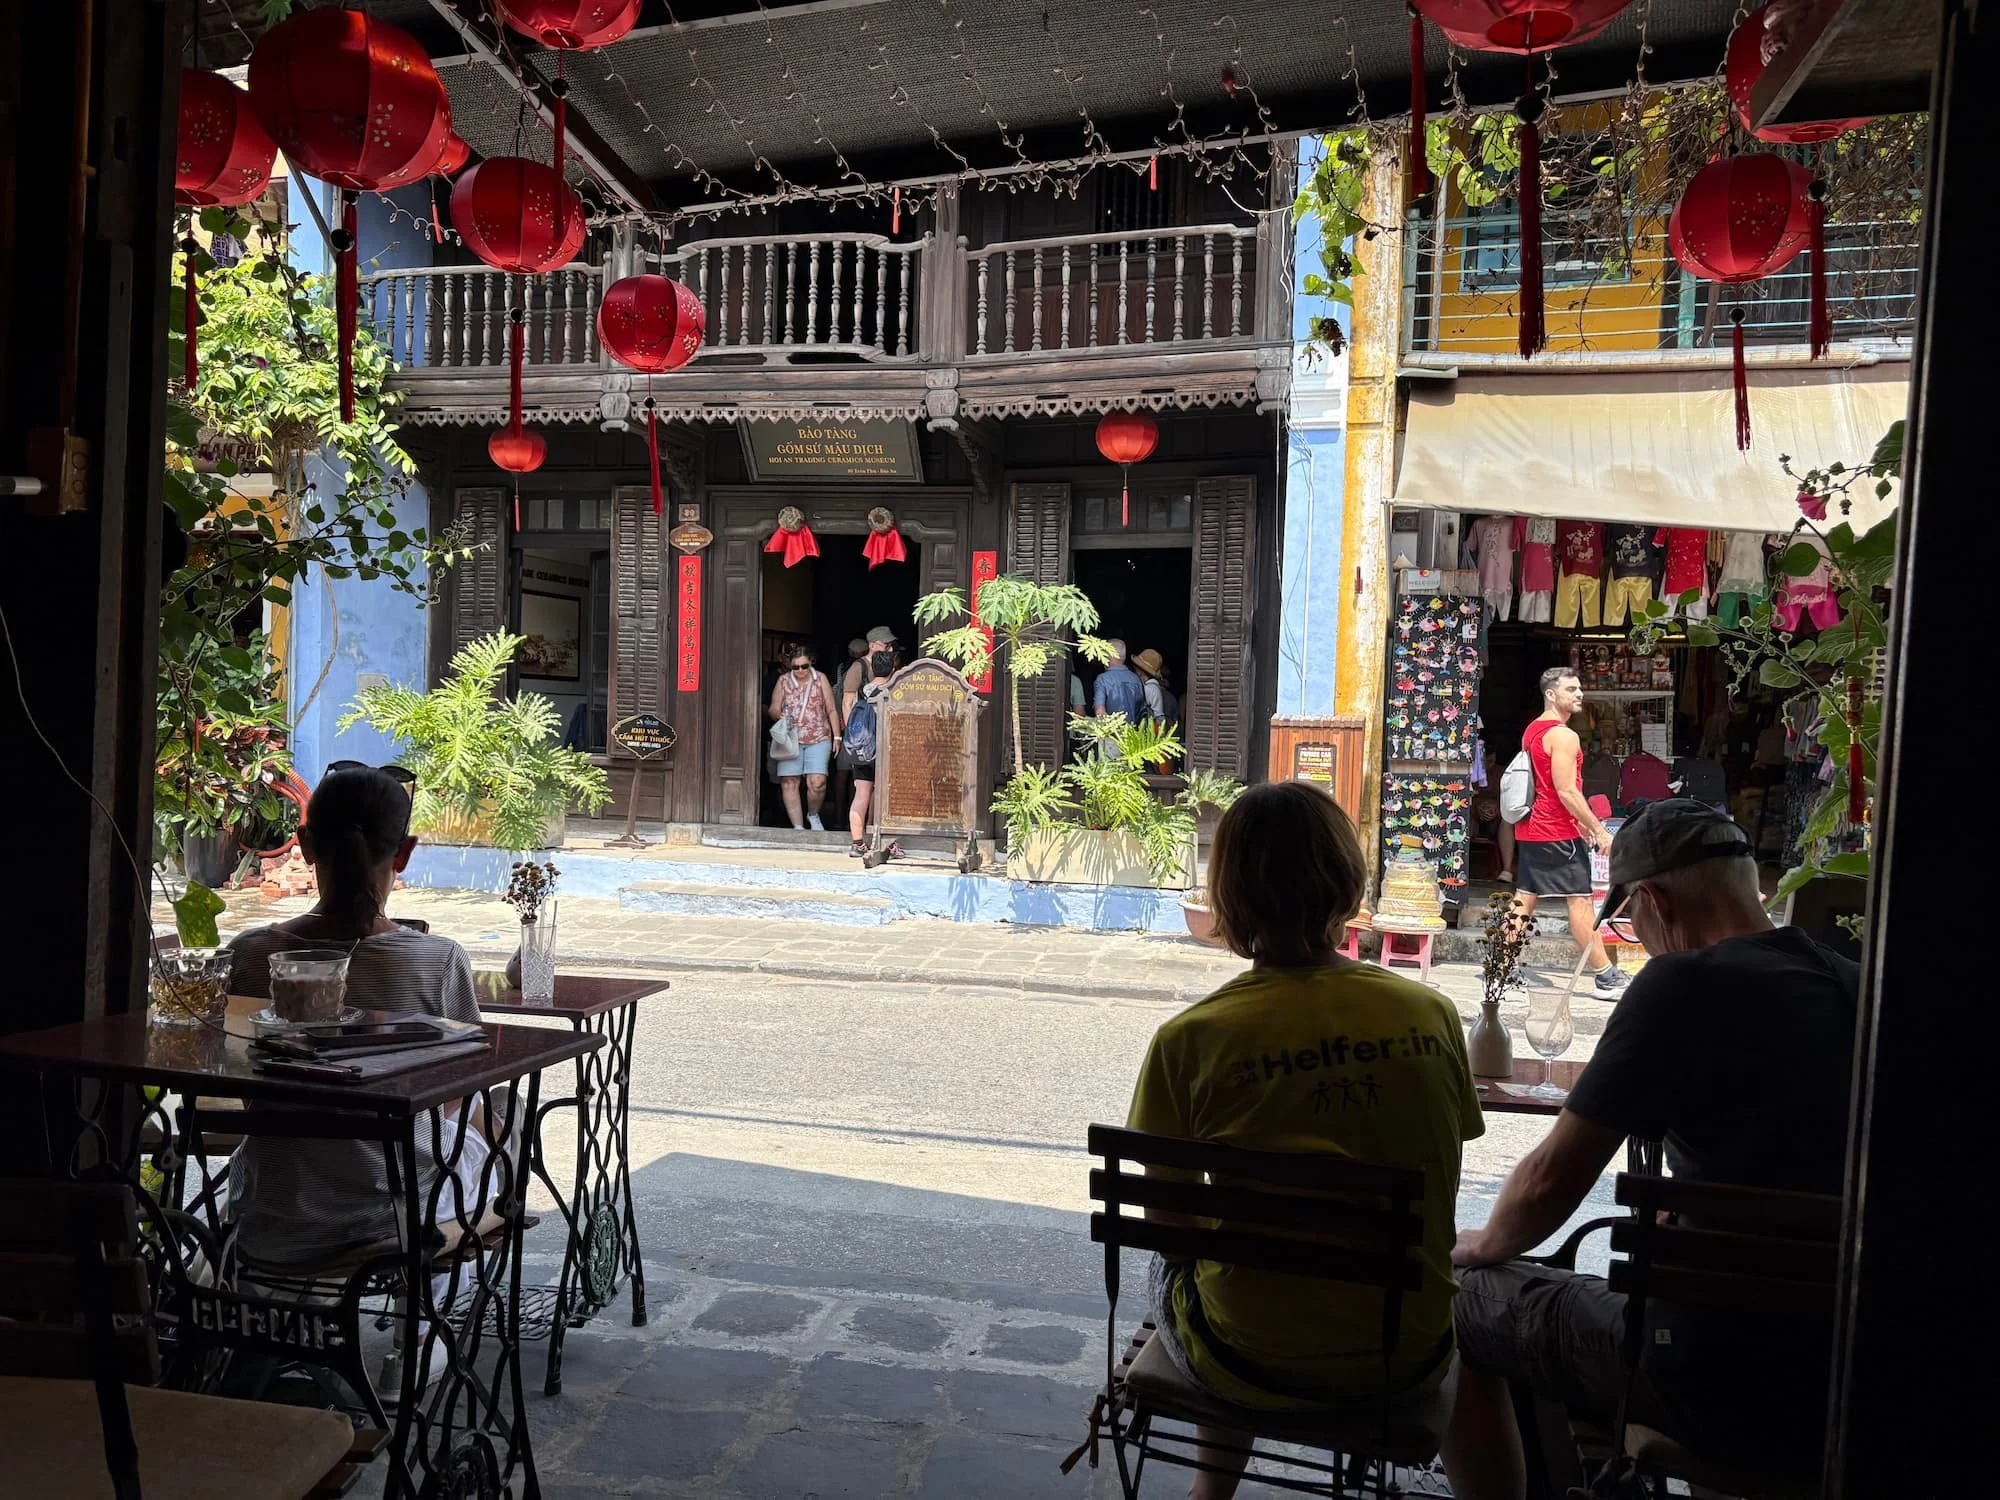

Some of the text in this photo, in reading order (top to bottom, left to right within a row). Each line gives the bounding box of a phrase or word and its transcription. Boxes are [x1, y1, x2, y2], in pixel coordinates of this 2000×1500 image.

[798, 426, 857, 439] BẢO TÀNG
[777, 441, 804, 455] GỐM
[806, 441, 822, 455] SỨ
[854, 444, 883, 456] DỊCH
